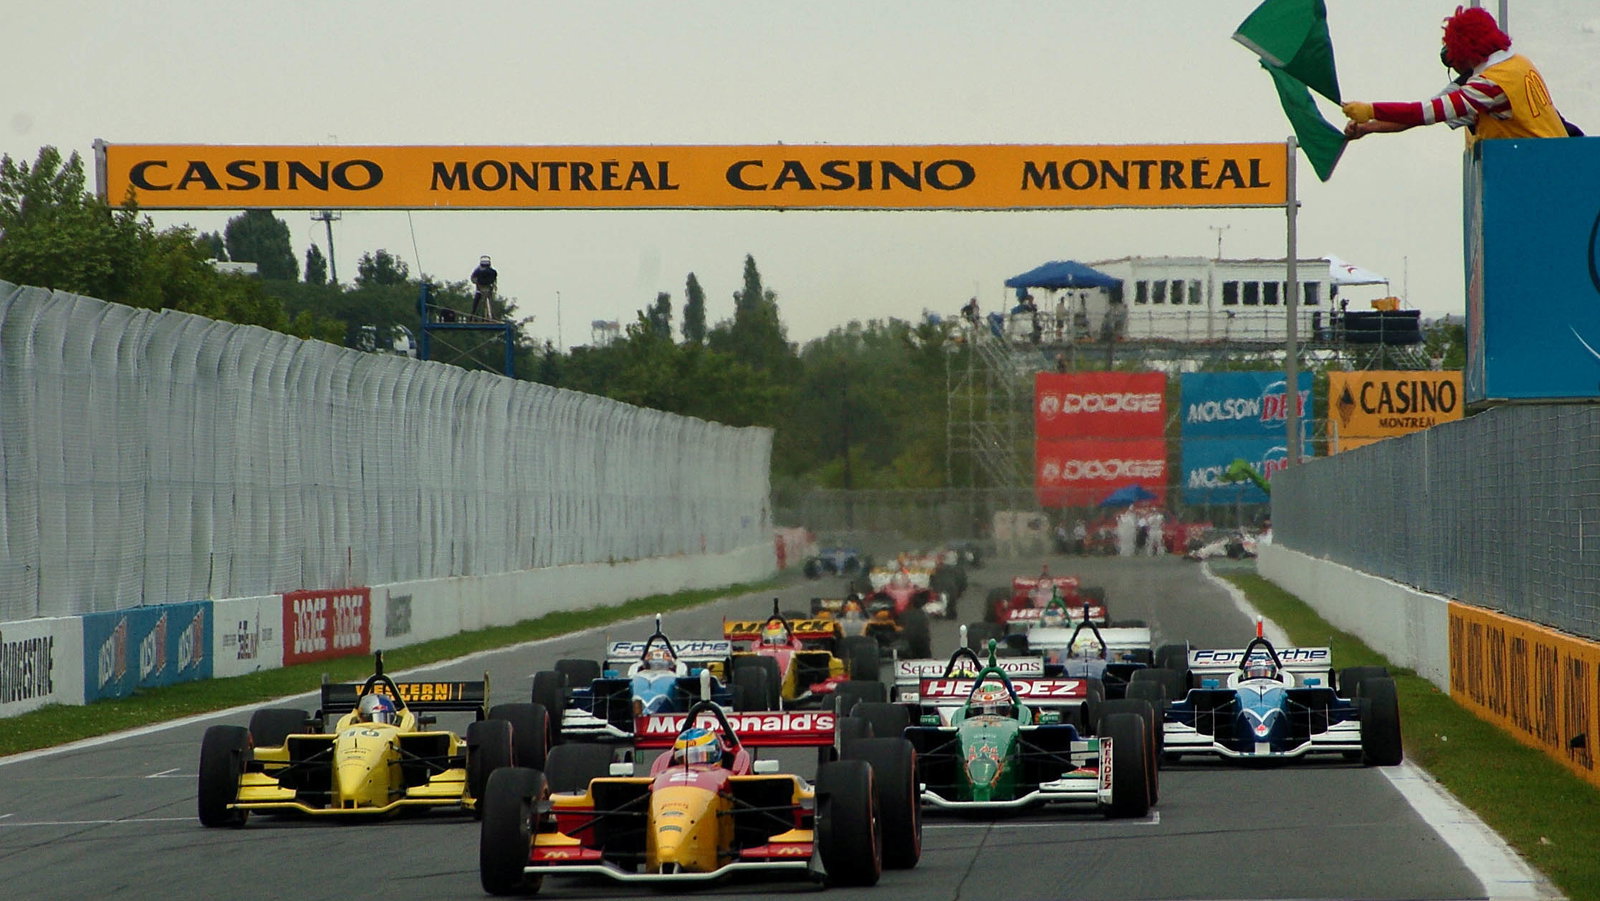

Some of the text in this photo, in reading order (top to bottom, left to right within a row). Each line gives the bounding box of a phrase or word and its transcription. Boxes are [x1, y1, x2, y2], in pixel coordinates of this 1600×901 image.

[129, 156, 1271, 192] CASINO MONTRÉAL CASINO MONTRÉAL
[1063, 393, 1161, 413] DODGE
[1188, 397, 1260, 424] MOLSON
[1360, 380, 1456, 414] CASINO
[1063, 459, 1164, 480] DODGE
